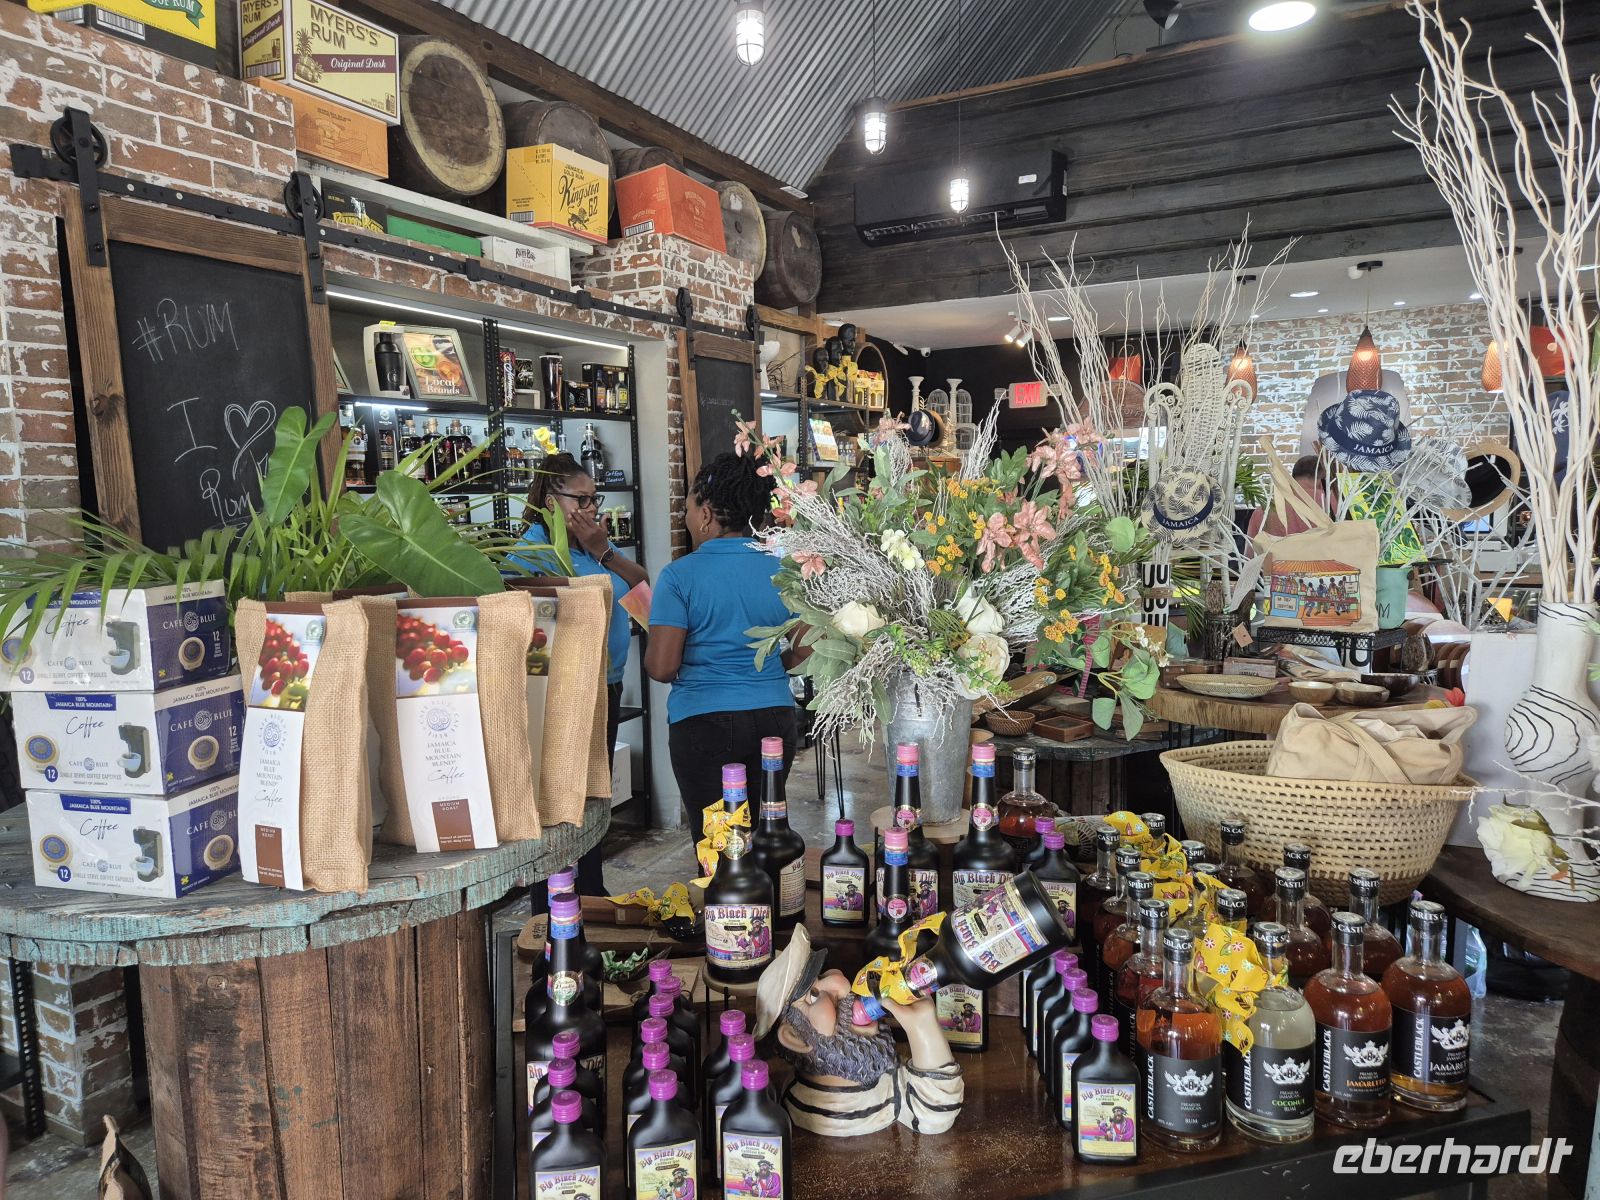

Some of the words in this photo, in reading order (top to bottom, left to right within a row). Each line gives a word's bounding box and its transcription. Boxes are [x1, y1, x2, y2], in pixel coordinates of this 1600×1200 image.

[242, 11, 262, 24] RUM
[310, 4, 379, 47] MYERS'S
[243, 25, 265, 48] Original
[310, 21, 347, 50] RUM
[331, 57, 364, 72] Original
[365, 57, 387, 69] Dark
[558, 174, 600, 212] Kingston
[588, 195, 598, 217] 62
[132, 298, 239, 362] #RUM
[425, 375, 455, 387] Local
[427, 386, 460, 395] Brands
[1015, 383, 1042, 404] EXIT
[166, 397, 218, 464] I
[1353, 444, 1395, 454] JAMAICA
[1162, 516, 1200, 527] JAMAICA
[162, 619, 184, 630] CAFE
[199, 613, 217, 624] BLUE
[212, 630, 221, 642] 12
[21, 670, 32, 681] 12
[173, 693, 195, 704] JAMAICA
[66, 716, 104, 739] Coffee
[170, 719, 194, 732] CAFE
[213, 709, 233, 721] BLUE
[228, 725, 238, 737] 12
[427, 741, 457, 749] JAMAICA
[425, 753, 461, 761] MOUNTAIN
[47, 768, 56, 779] 12
[427, 766, 465, 784] Coffee
[188, 795, 209, 807] JAMAICA
[254, 787, 283, 808] Coffee
[79, 818, 119, 841] Coffee
[186, 820, 209, 835] CAFE
[60, 868, 69, 879] 12
[953, 872, 966, 885] Big
[966, 871, 996, 884] Black
[717, 906, 748, 919] Black
[978, 949, 1003, 974] Big
[1413, 1017, 1425, 1078] CASTLEBLACK
[1322, 1028, 1333, 1092] CASTLEBLACK
[528, 1065, 544, 1079] Big
[1081, 1092, 1094, 1101] Big
[1094, 1087, 1115, 1096] Black
[1115, 1088, 1133, 1102] Dick
[1147, 1054, 1155, 1119] CASTLEBLACK
[1271, 1099, 1306, 1107] COCONUT
[727, 1141, 740, 1153] Big
[740, 1138, 761, 1148] Black
[762, 1142, 778, 1156] Dick
[640, 1157, 653, 1169] Big
[653, 1148, 675, 1161] Black
[675, 1149, 693, 1161] Dick
[539, 1179, 554, 1193] Big
[554, 1172, 578, 1185] Black
[577, 1174, 597, 1187] Dick
